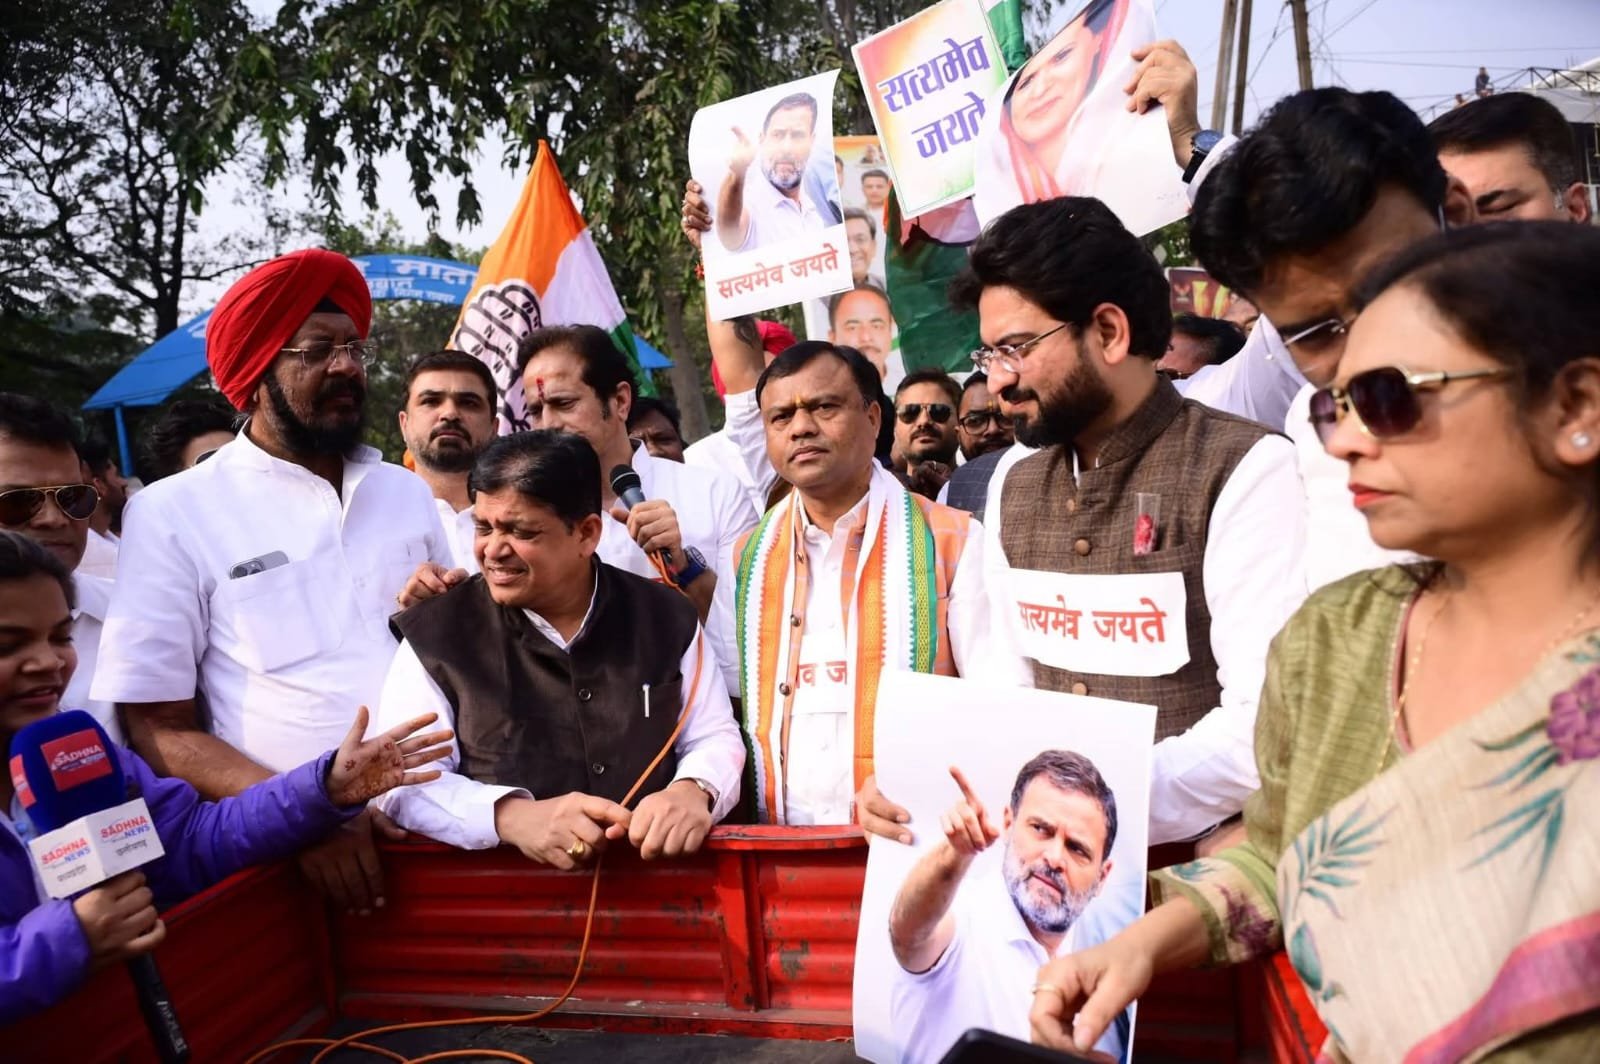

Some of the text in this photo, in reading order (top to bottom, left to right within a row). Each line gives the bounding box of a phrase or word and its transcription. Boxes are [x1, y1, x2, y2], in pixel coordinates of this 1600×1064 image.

[878, 36, 990, 112] सत्यमेव
[911, 91, 986, 158] जयते
[716, 242, 839, 298] सत्यमेव जयते
[1091, 597, 1168, 642] जयते
[41, 837, 88, 865] SADHNA
[100, 815, 149, 839] SADHNA
